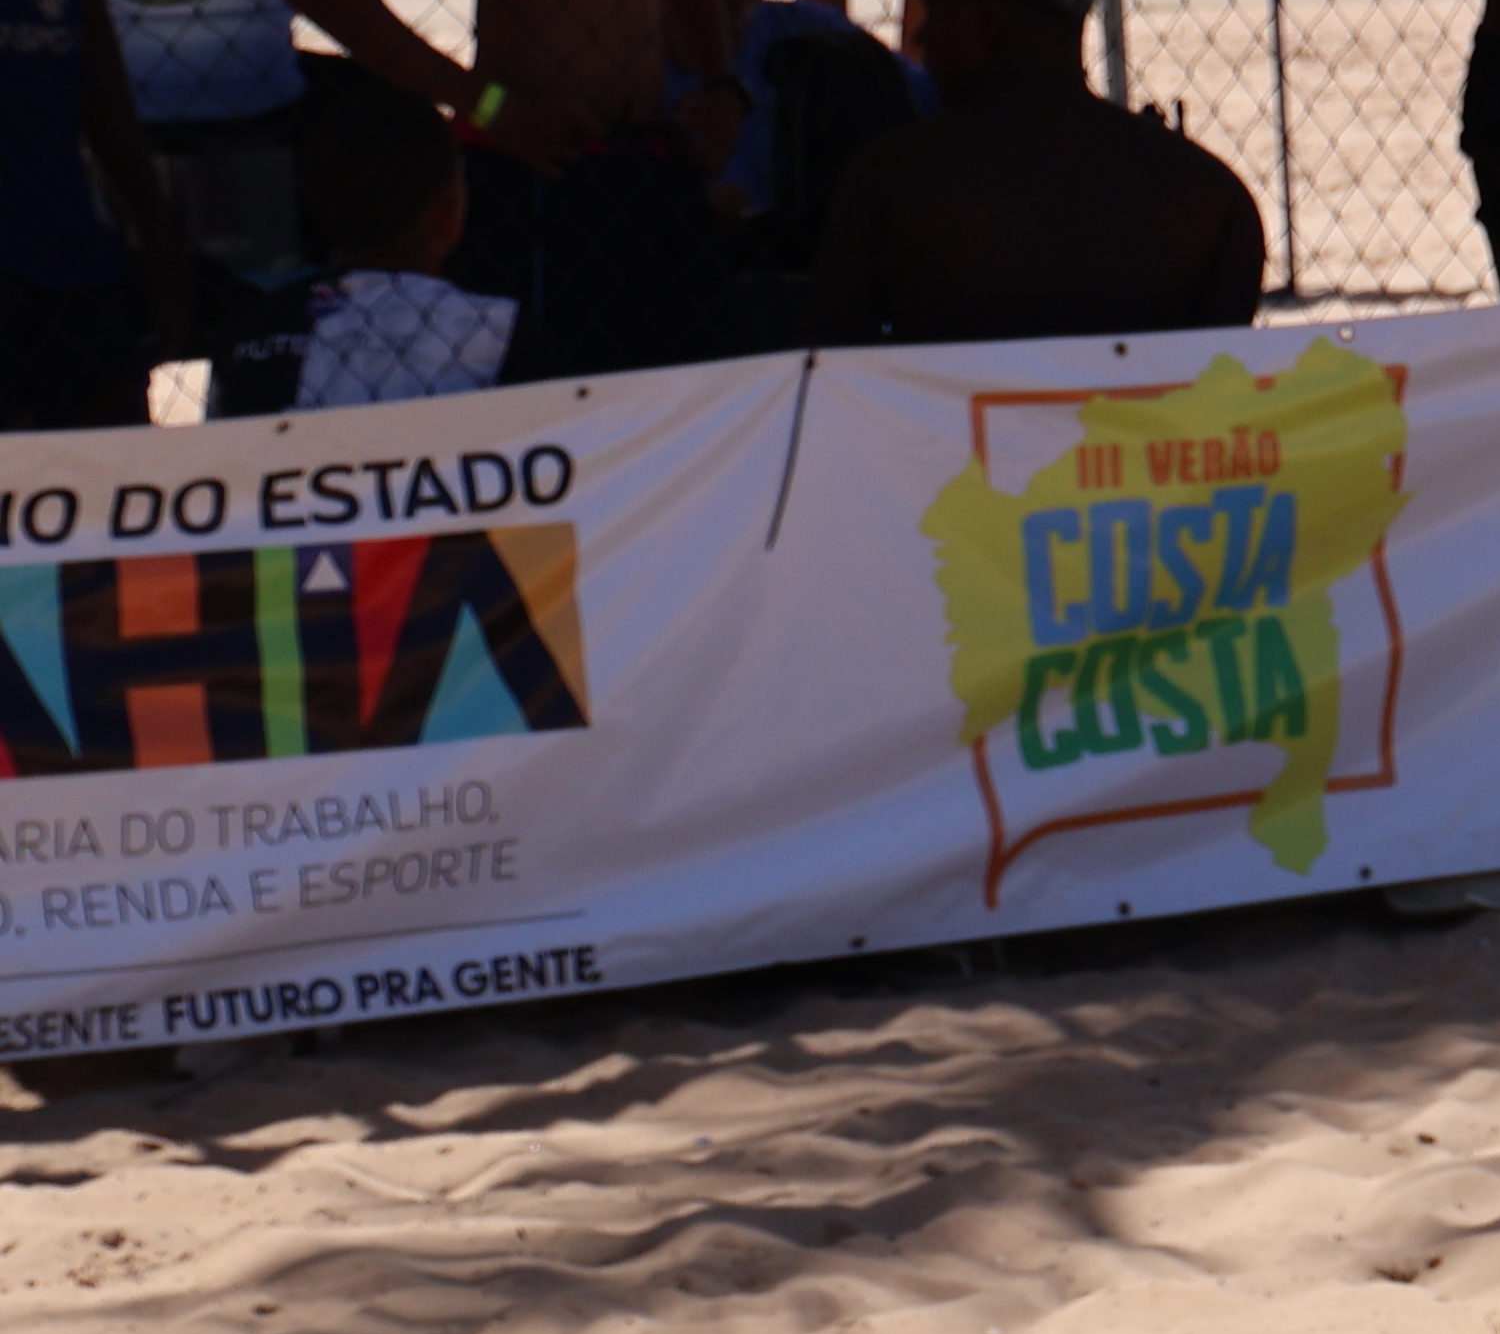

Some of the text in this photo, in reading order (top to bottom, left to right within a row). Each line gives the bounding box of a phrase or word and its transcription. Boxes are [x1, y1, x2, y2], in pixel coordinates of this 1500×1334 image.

[109, 478, 228, 539] DO
[259, 445, 573, 531] ESTADO
[1078, 426, 1282, 489] III VERÃO
[1022, 485, 1296, 647] COSTA
[1017, 616, 1307, 771] COSTA
[120, 807, 197, 859] DO
[42, 875, 237, 931] RENDA
[250, 870, 282, 914] E
[300, 838, 519, 909] ESPORTE
[164, 979, 342, 1034] FUTURO
[356, 967, 441, 1025] PRA
[455, 946, 603, 999] GENTE
